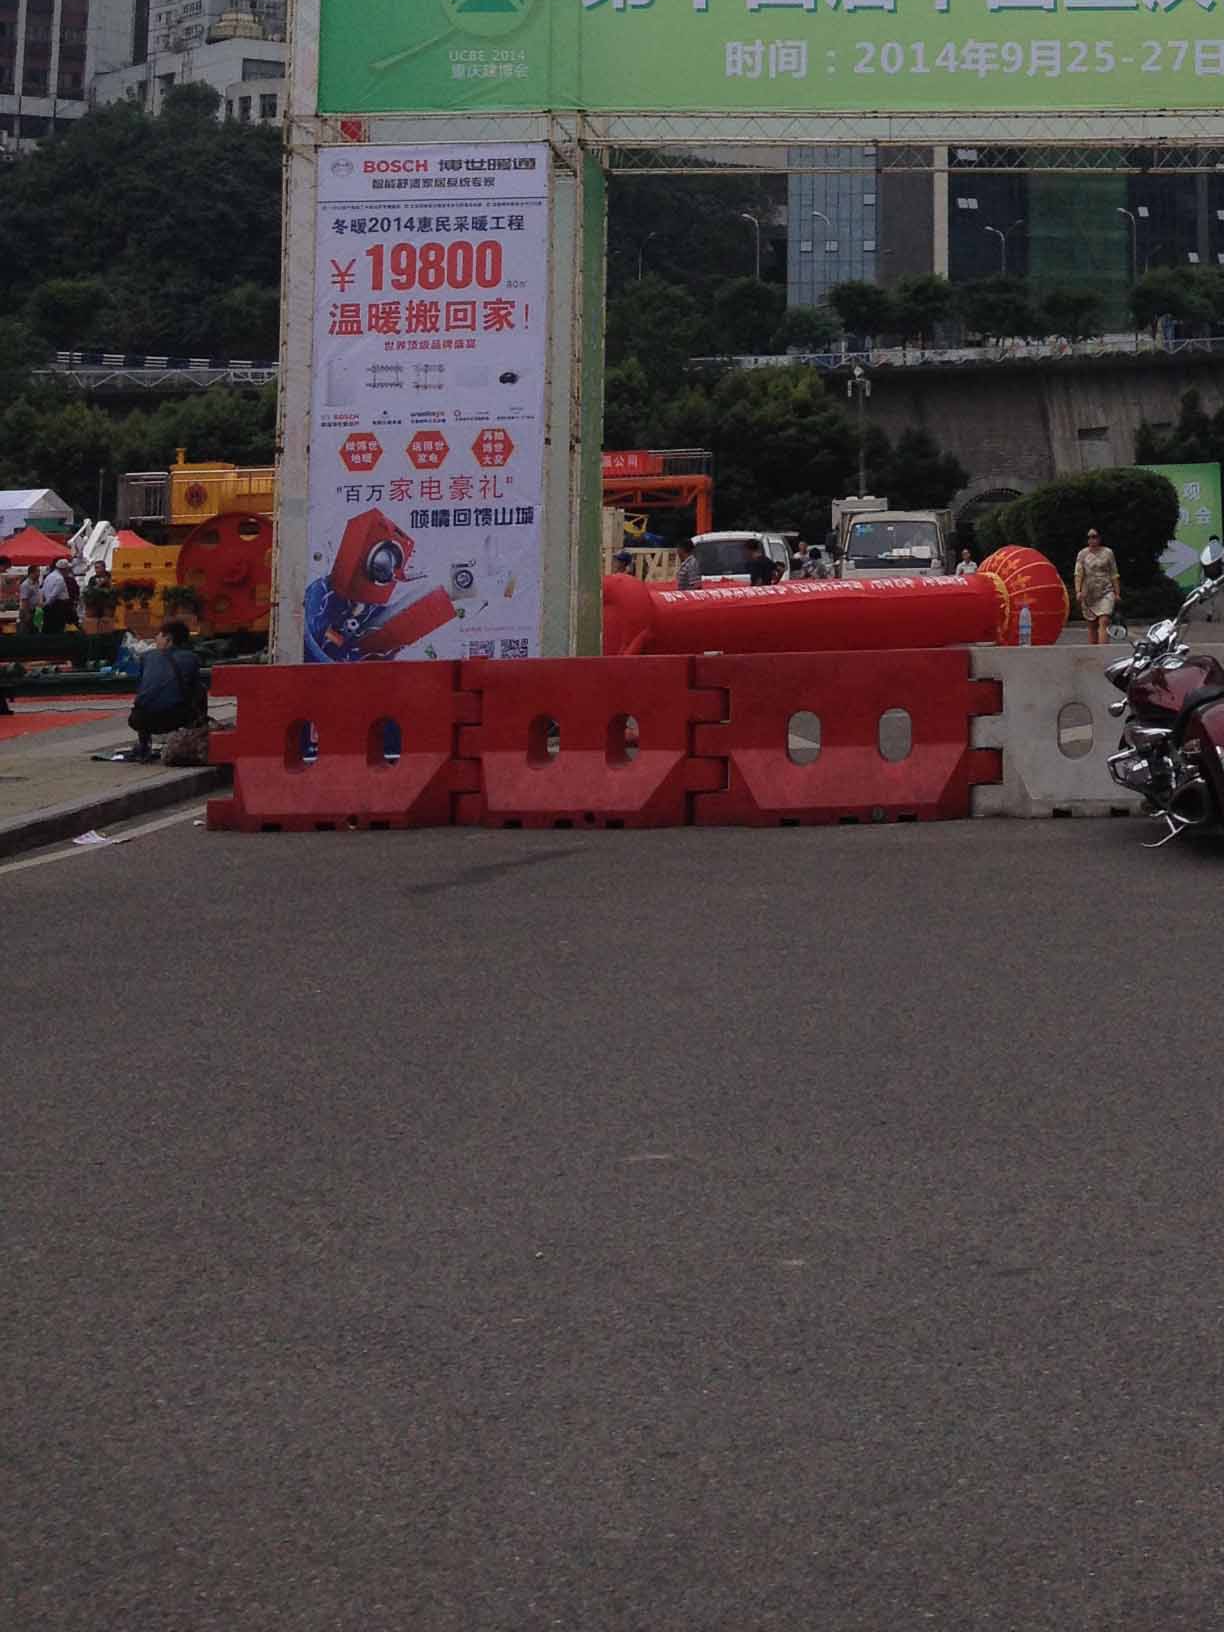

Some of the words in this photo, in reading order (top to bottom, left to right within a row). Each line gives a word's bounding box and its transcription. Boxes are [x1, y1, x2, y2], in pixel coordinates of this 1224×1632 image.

[449, 50, 488, 62] UCBE
[493, 50, 526, 62] 2014
[363, 159, 429, 173] BOSCH
[332, 215, 525, 235] 冬暖2014惠民采暖工程
[411, 507, 534, 528] 倾情回馈山城
